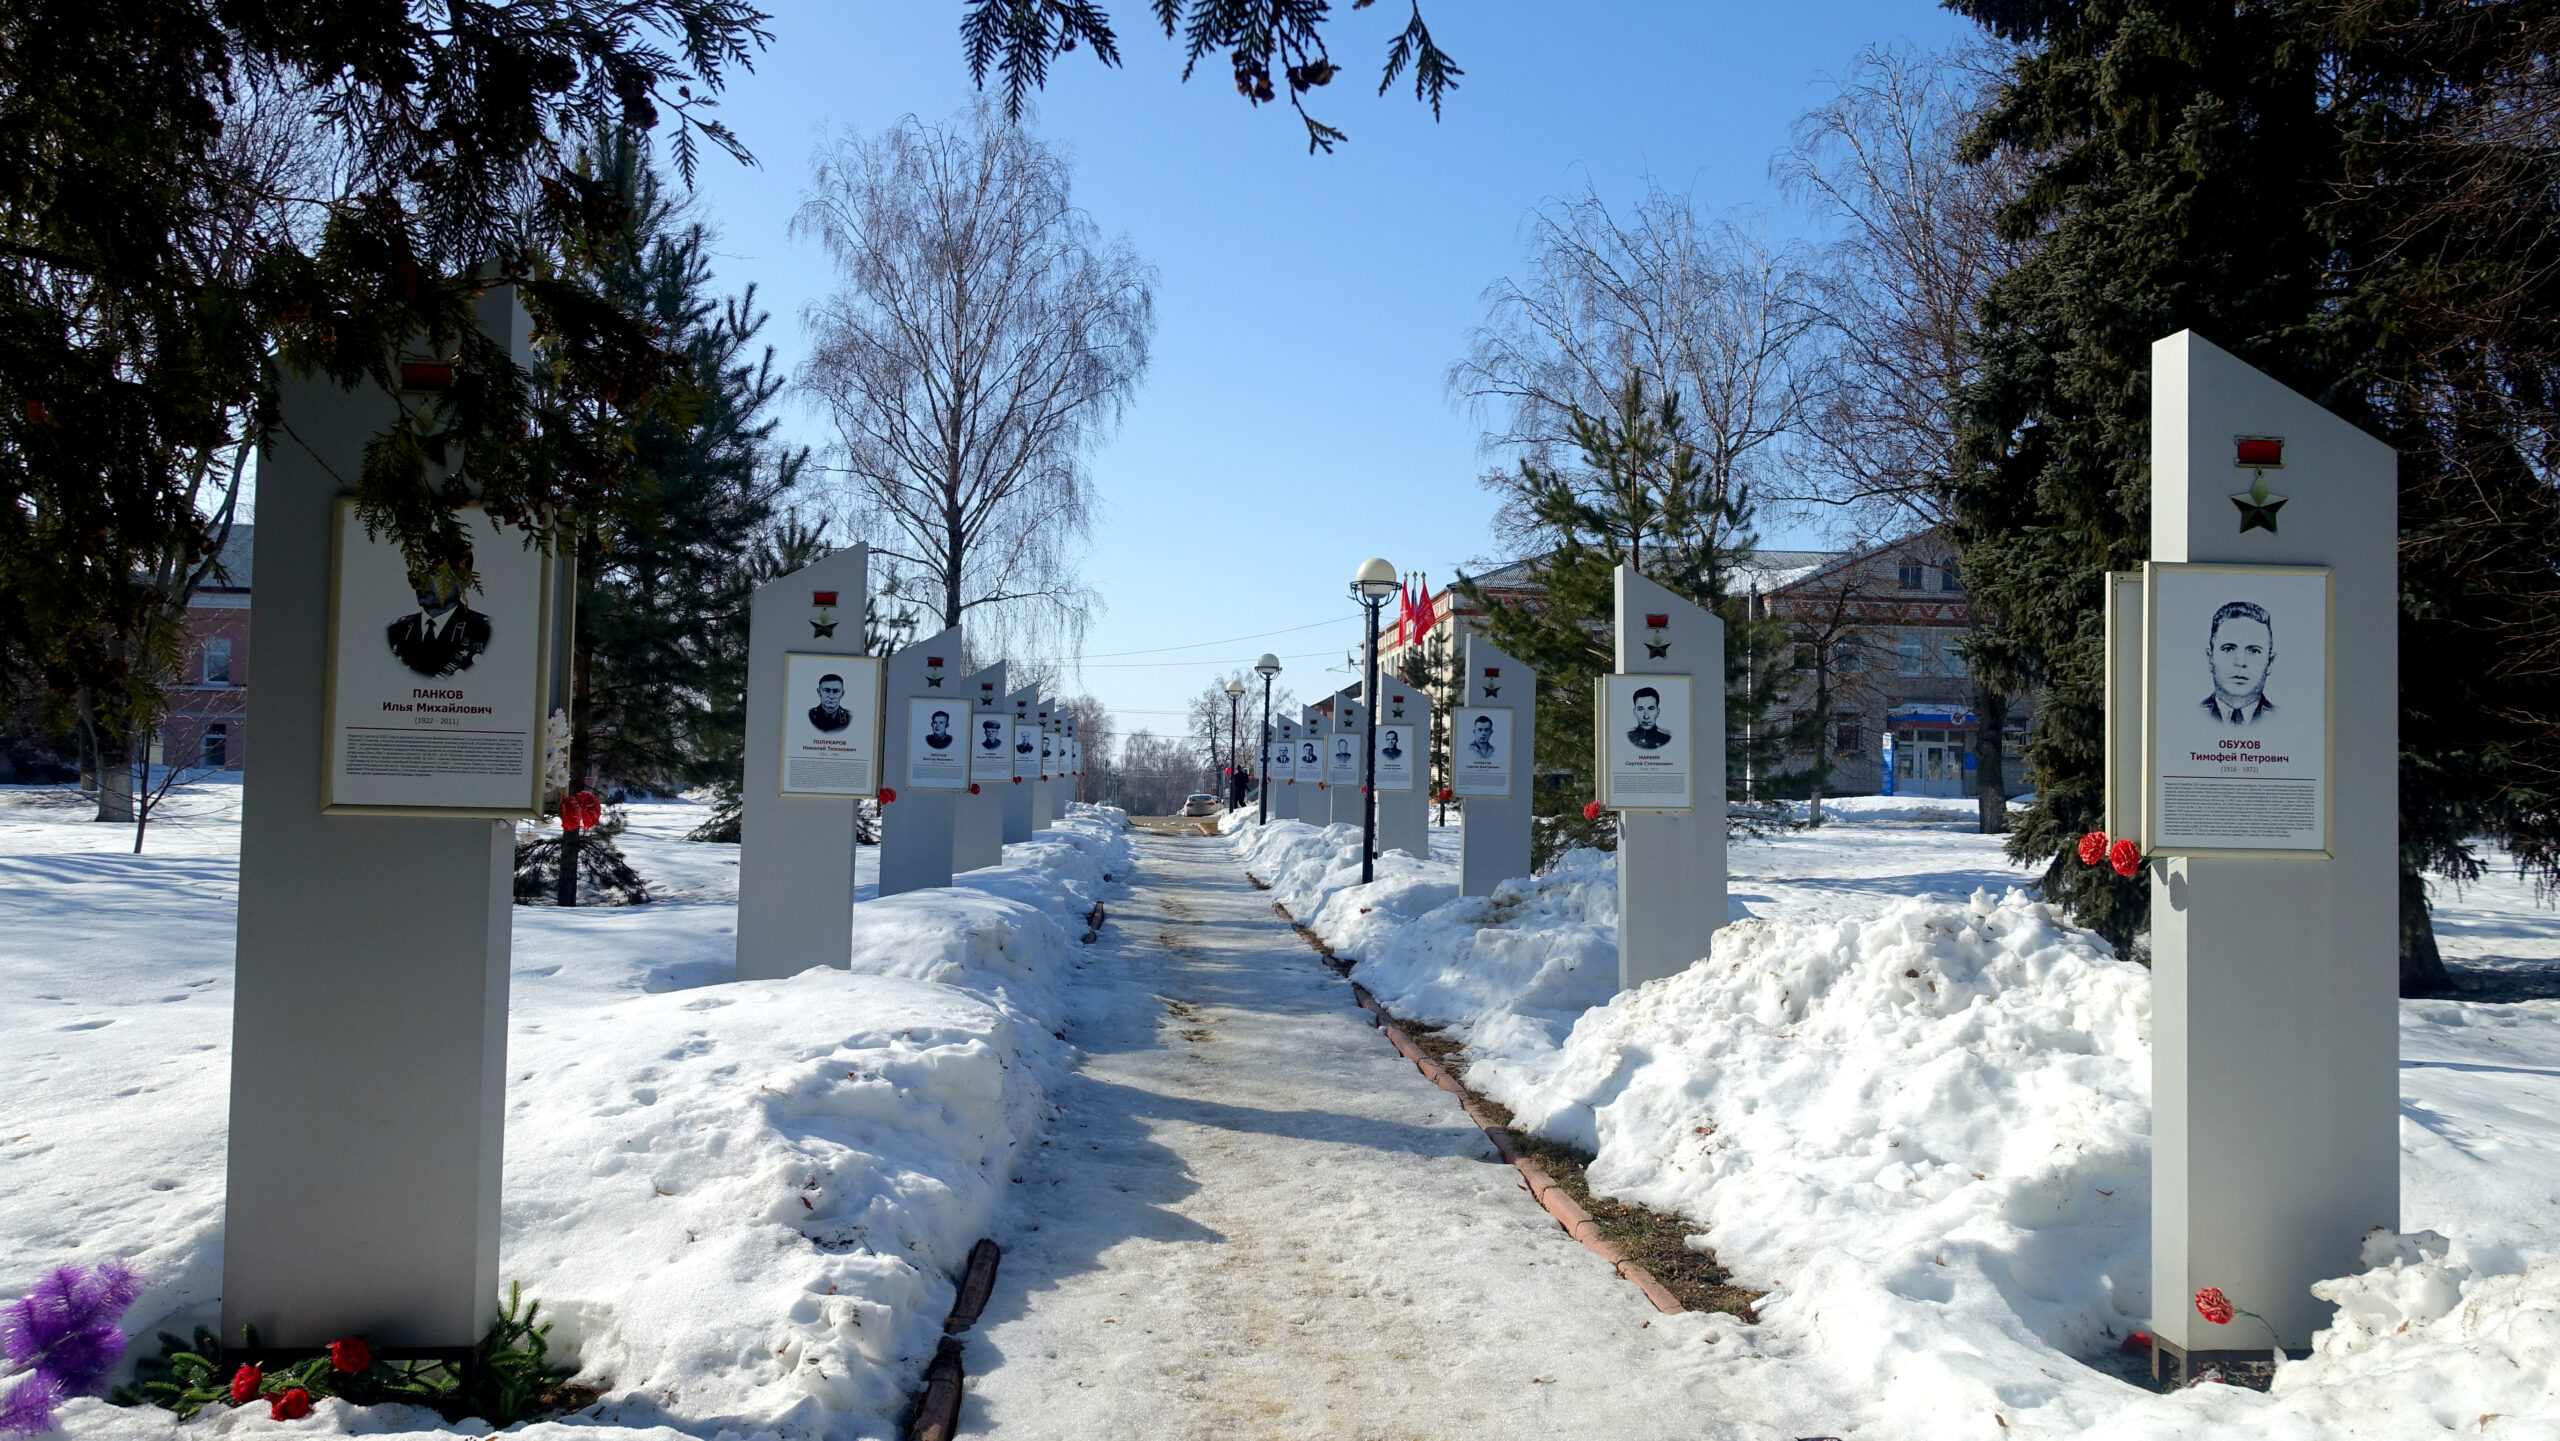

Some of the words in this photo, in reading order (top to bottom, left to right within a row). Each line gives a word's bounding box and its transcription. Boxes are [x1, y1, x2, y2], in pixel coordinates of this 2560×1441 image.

[413, 688, 464, 700] ПАНКОВ
[382, 701, 413, 712] Илья
[416, 702, 493, 715] Михайлович
[414, 717, 434, 725] (1922
[440, 718, 460, 726] 2011)
[2218, 739, 2261, 750] ОБУХОВ
[2190, 751, 2237, 763] Тимофей
[2240, 753, 2289, 764] Петрович
